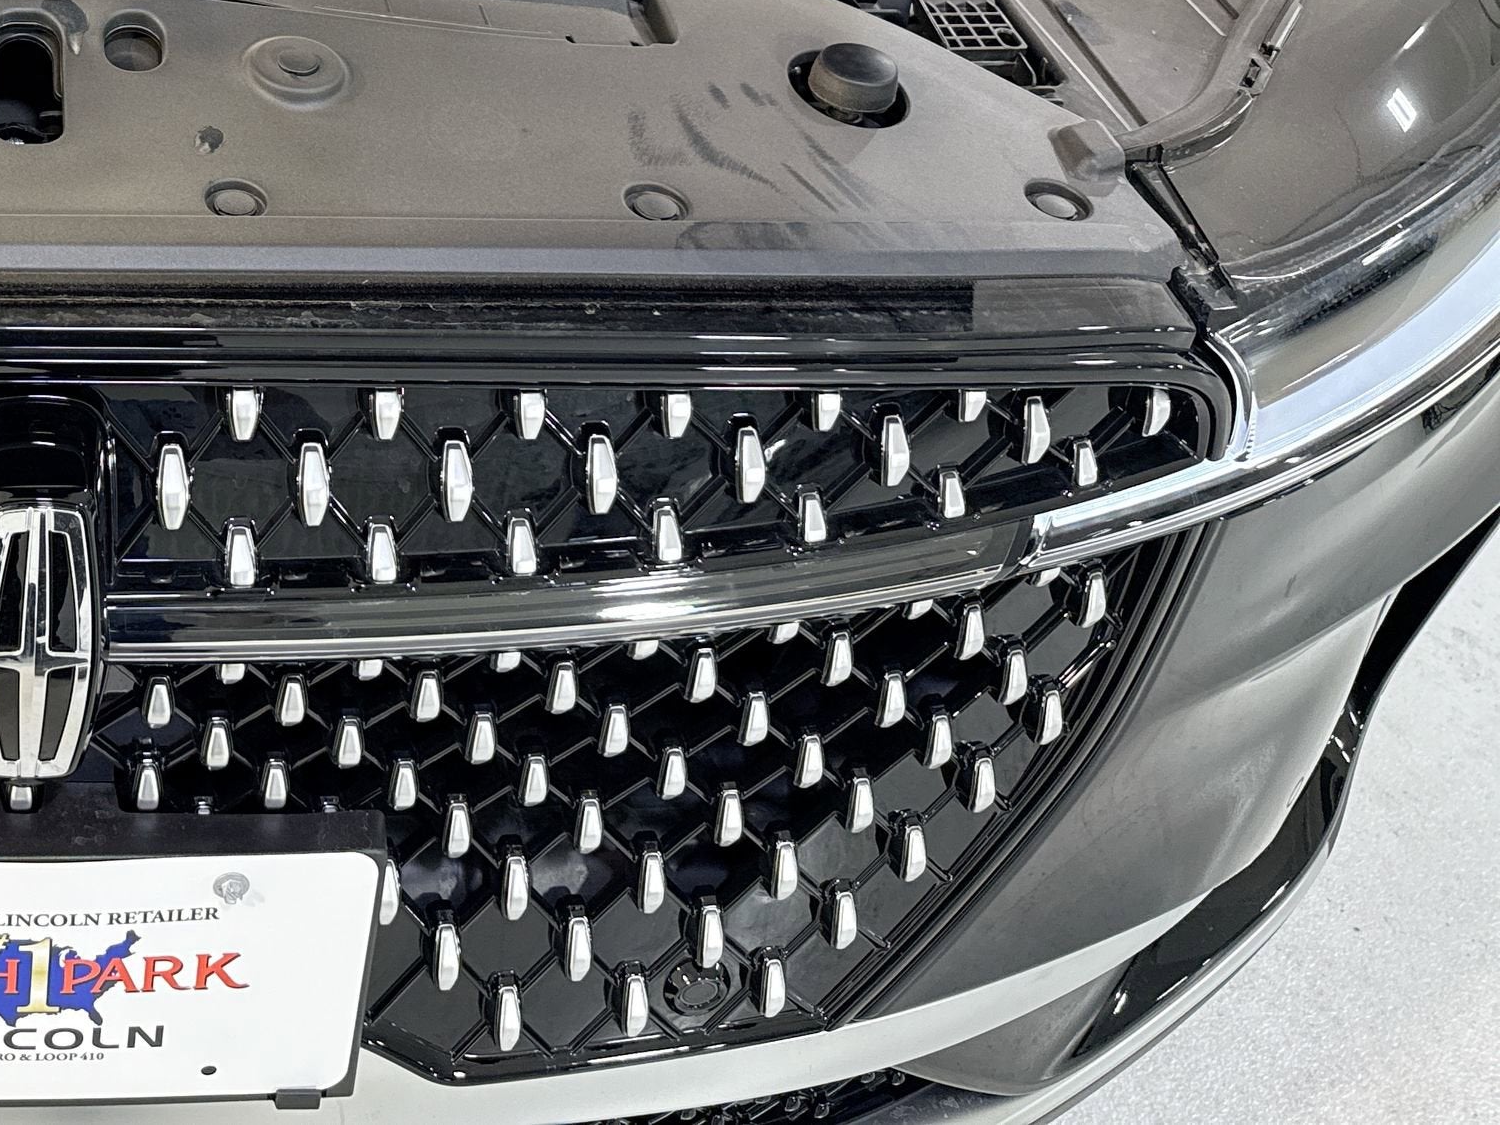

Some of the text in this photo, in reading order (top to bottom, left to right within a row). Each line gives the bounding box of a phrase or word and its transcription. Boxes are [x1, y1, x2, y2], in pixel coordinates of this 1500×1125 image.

[107, 907, 220, 925] RETAILER
[59, 952, 251, 994] PARK
[19, 1053, 32, 1062] &
[35, 1052, 78, 1062] LOOP
[80, 1051, 105, 1061] 410
